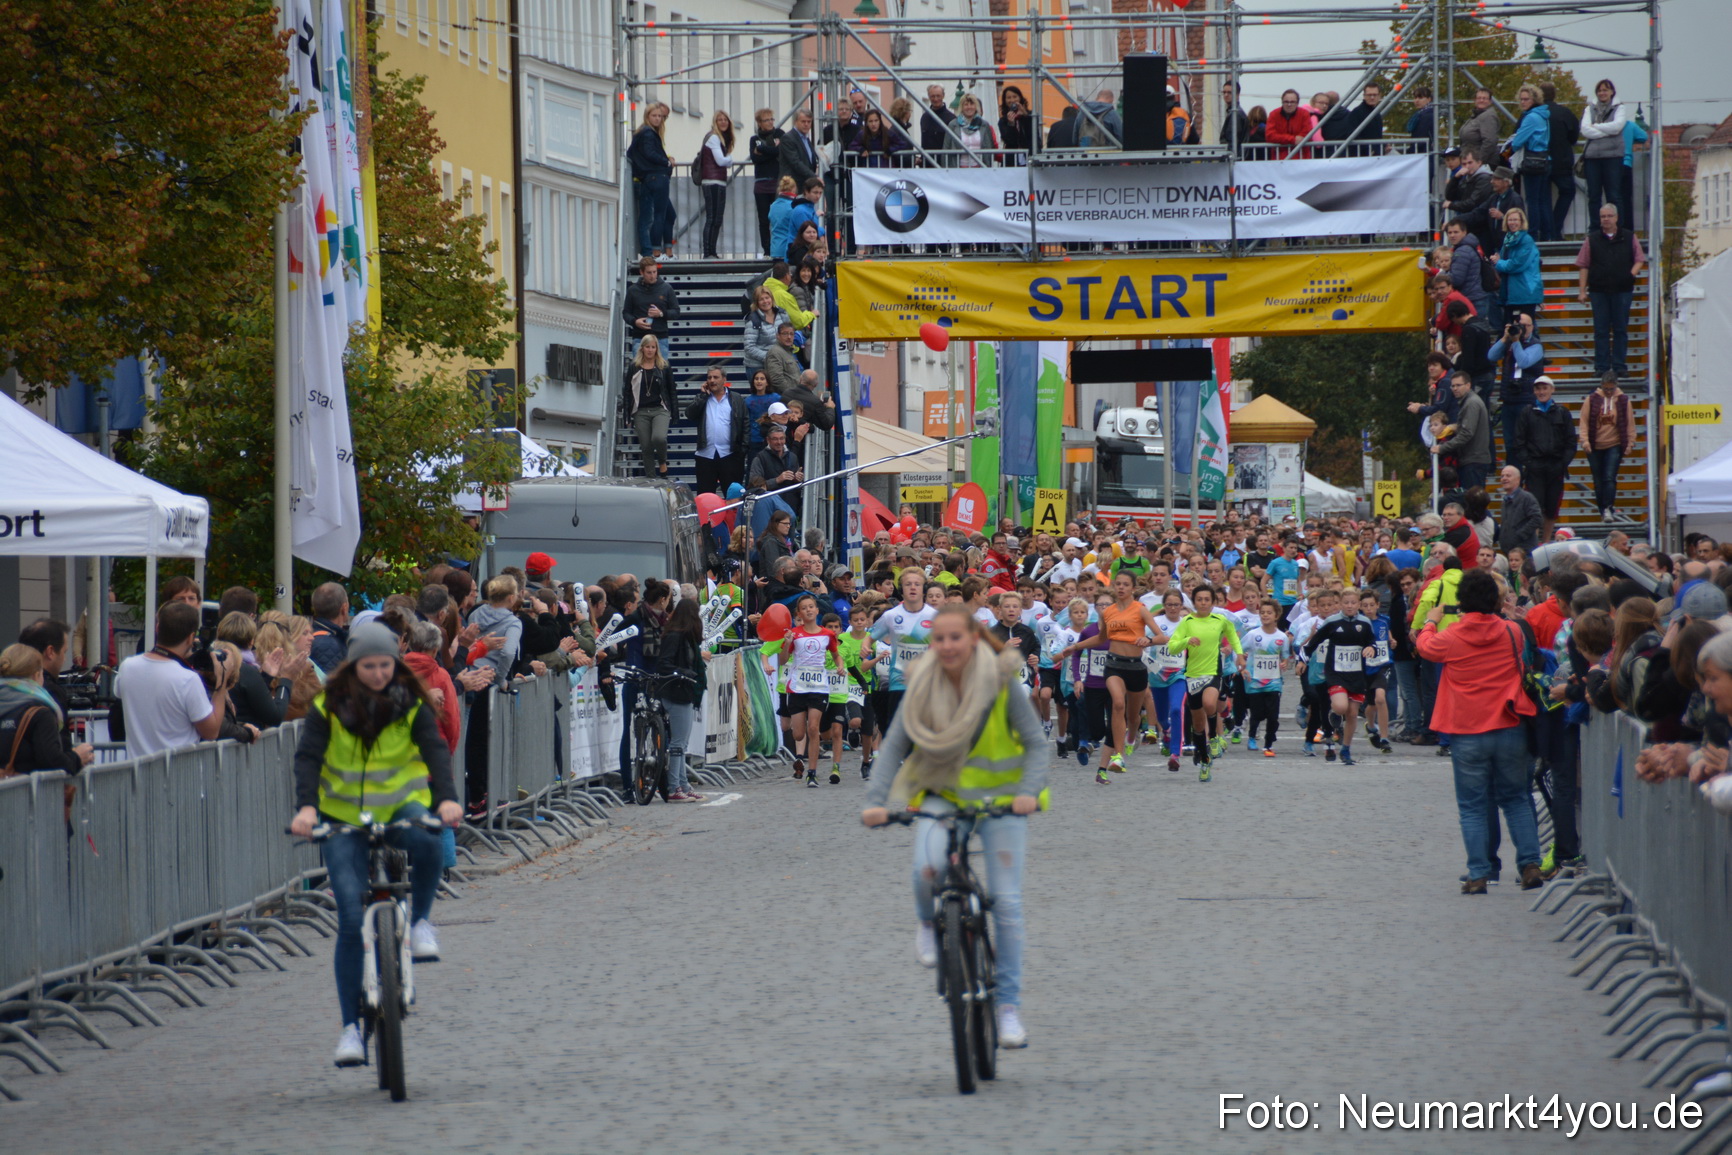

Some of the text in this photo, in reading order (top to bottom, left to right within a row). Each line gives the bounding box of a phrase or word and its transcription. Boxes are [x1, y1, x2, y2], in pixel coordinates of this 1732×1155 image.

[1003, 190, 1056, 207] BMW
[1004, 210, 1063, 222] WENGER
[1066, 208, 1149, 221] VERBRAUCH.
[1152, 207, 1190, 219] MEHR
[1027, 273, 1228, 321] START
[1264, 292, 1391, 306] Neumarkter Stadtlauf
[869, 301, 994, 312] Neumarkter Stadtlauf
[1665, 410, 1712, 420] Toiletten
[903, 473, 942, 483] Klostergasse
[1200, 481, 1215, 494] 52
[1377, 482, 1398, 490] Block
[1039, 489, 1064, 501] Block
[1381, 492, 1394, 511] C
[958, 513, 972, 522] DKMS
[1040, 502, 1059, 527] A
[1338, 652, 1360, 662] 4100
[1256, 660, 1278, 670] 4104
[799, 672, 822, 683] 4040
